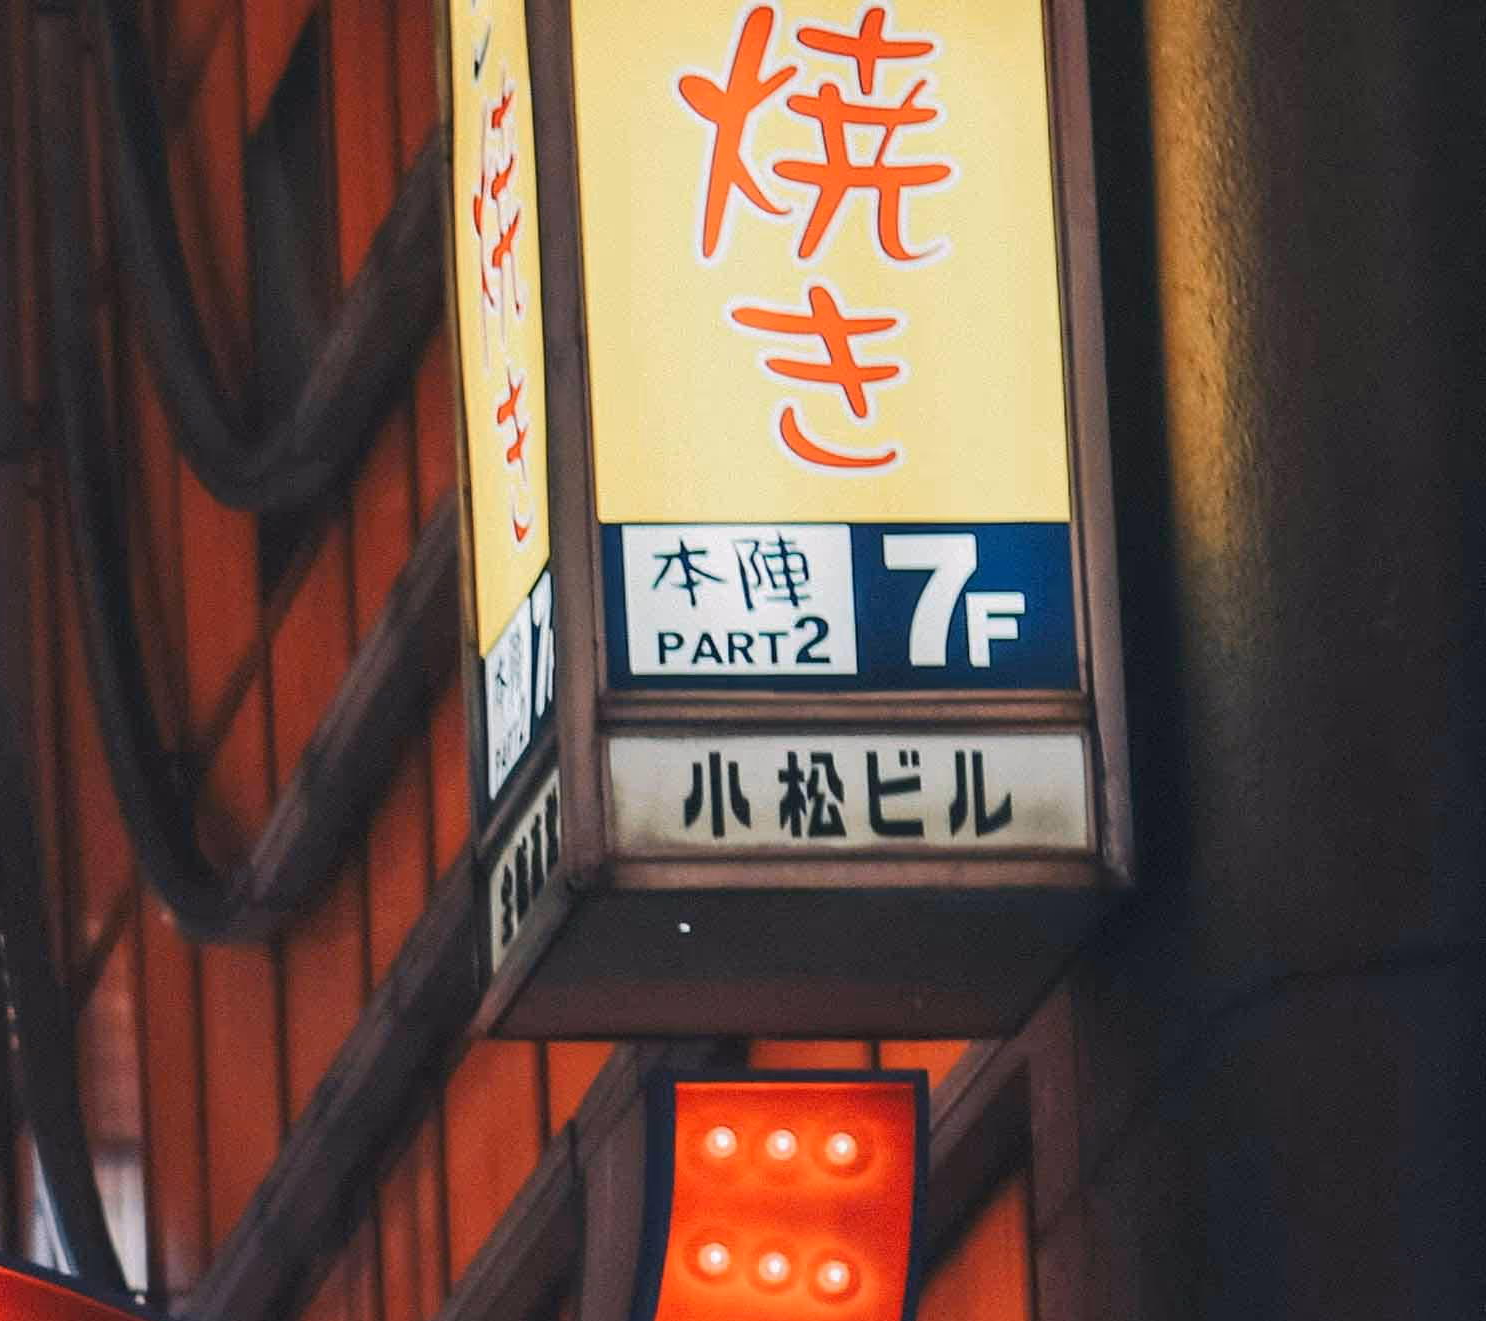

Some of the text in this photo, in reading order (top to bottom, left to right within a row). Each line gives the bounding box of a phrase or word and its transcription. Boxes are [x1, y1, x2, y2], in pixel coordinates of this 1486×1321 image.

[652, 534, 812, 612] 本陣
[882, 532, 1026, 669] 7F
[656, 615, 833, 668] PART2
[683, 750, 1013, 840] 小松ビル
